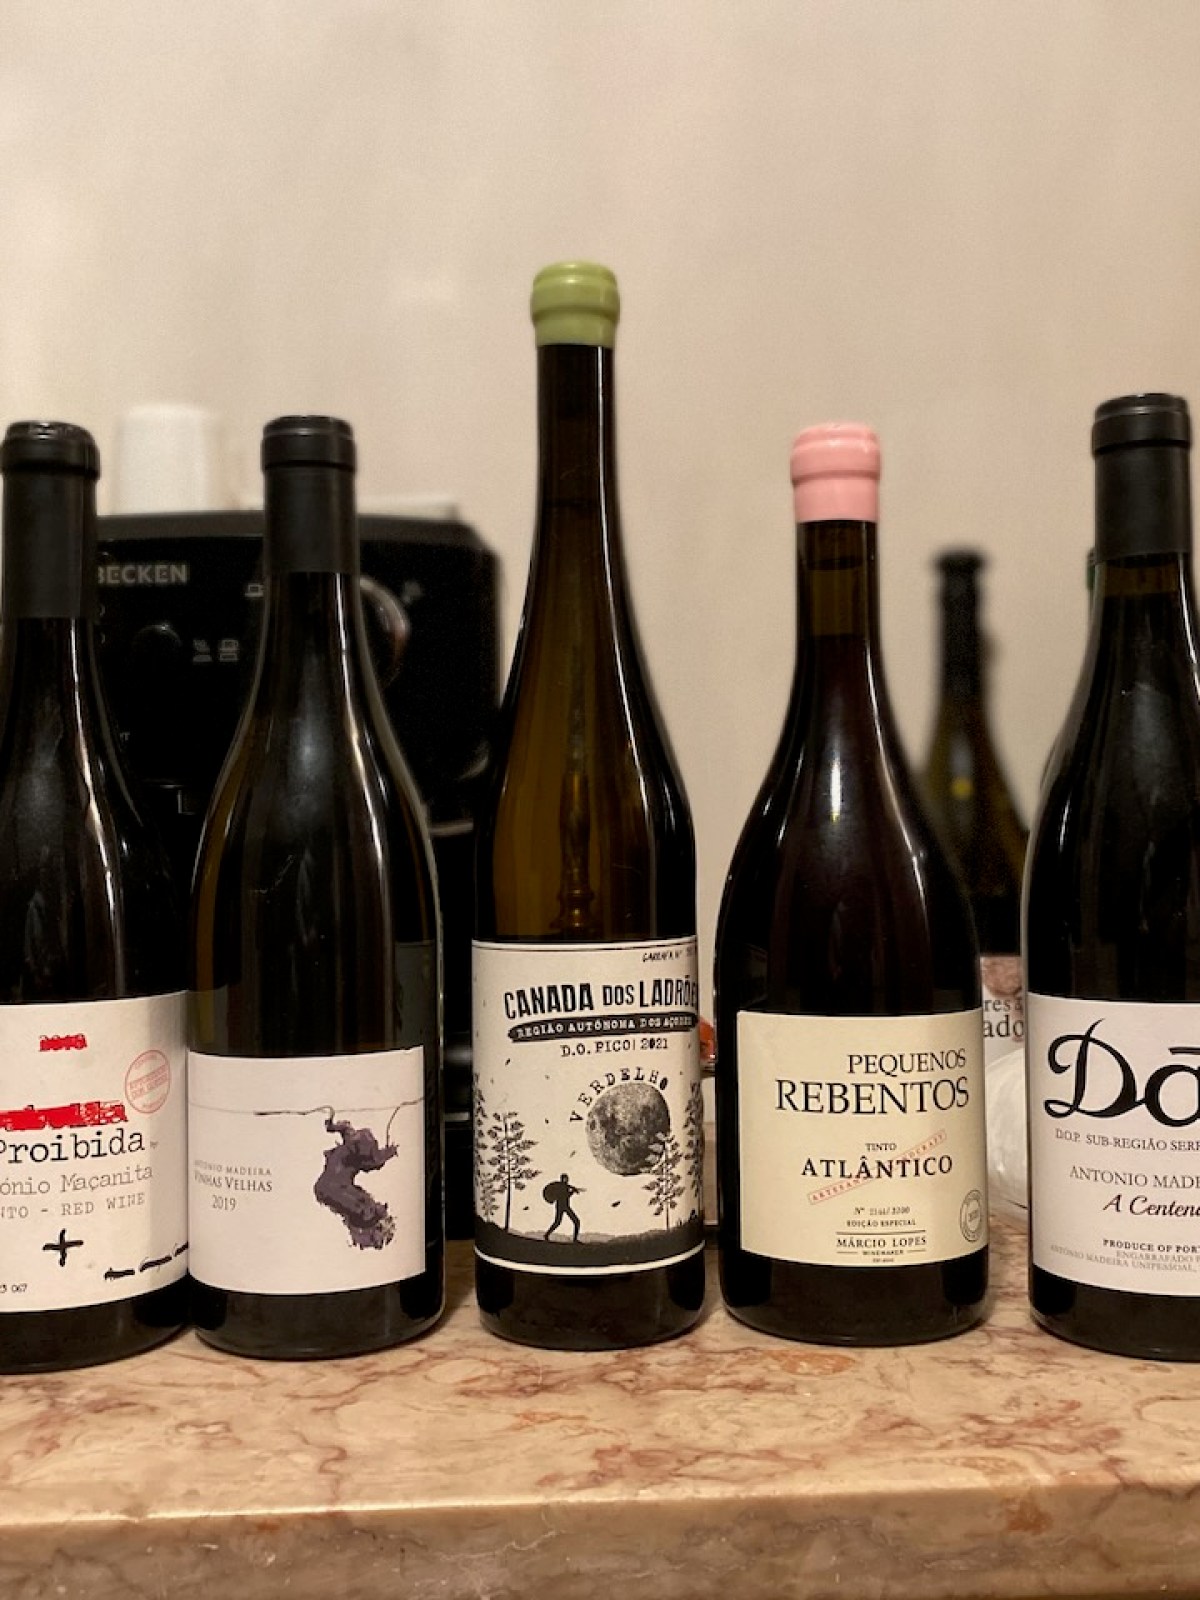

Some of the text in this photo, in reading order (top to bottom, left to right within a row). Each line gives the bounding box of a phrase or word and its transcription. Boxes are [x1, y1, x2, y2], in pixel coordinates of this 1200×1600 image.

[504, 982, 595, 1020] CANADA
[602, 984, 635, 1006] DOS
[848, 1048, 966, 1077] PEQUENOS
[569, 1066, 668, 1122] VERDELHO
[775, 1076, 970, 1114] REBENTOS
[865, 1143, 897, 1151] TINTO
[225, 1166, 272, 1175] MADEIRA
[801, 1155, 953, 1178] ATLÂNTICO
[1069, 1165, 1148, 1187] ANTONIO
[60, 1165, 153, 1193] Maçanita
[224, 1176, 273, 1192] VELHAS
[61, 1202, 95, 1215] RED
[106, 1193, 145, 1210] WINE
[211, 1194, 237, 1211] 2019
[1102, 1194, 1122, 1213] A
[846, 1219, 916, 1228] EDIÇÃO ESPECIAL
[836, 1236, 926, 1248] MÁRCIO LOPES
[1102, 1239, 1154, 1251] PRODUCE
[1157, 1244, 1173, 1252] OF
[1086, 1252, 1129, 1267] MADEIRA
